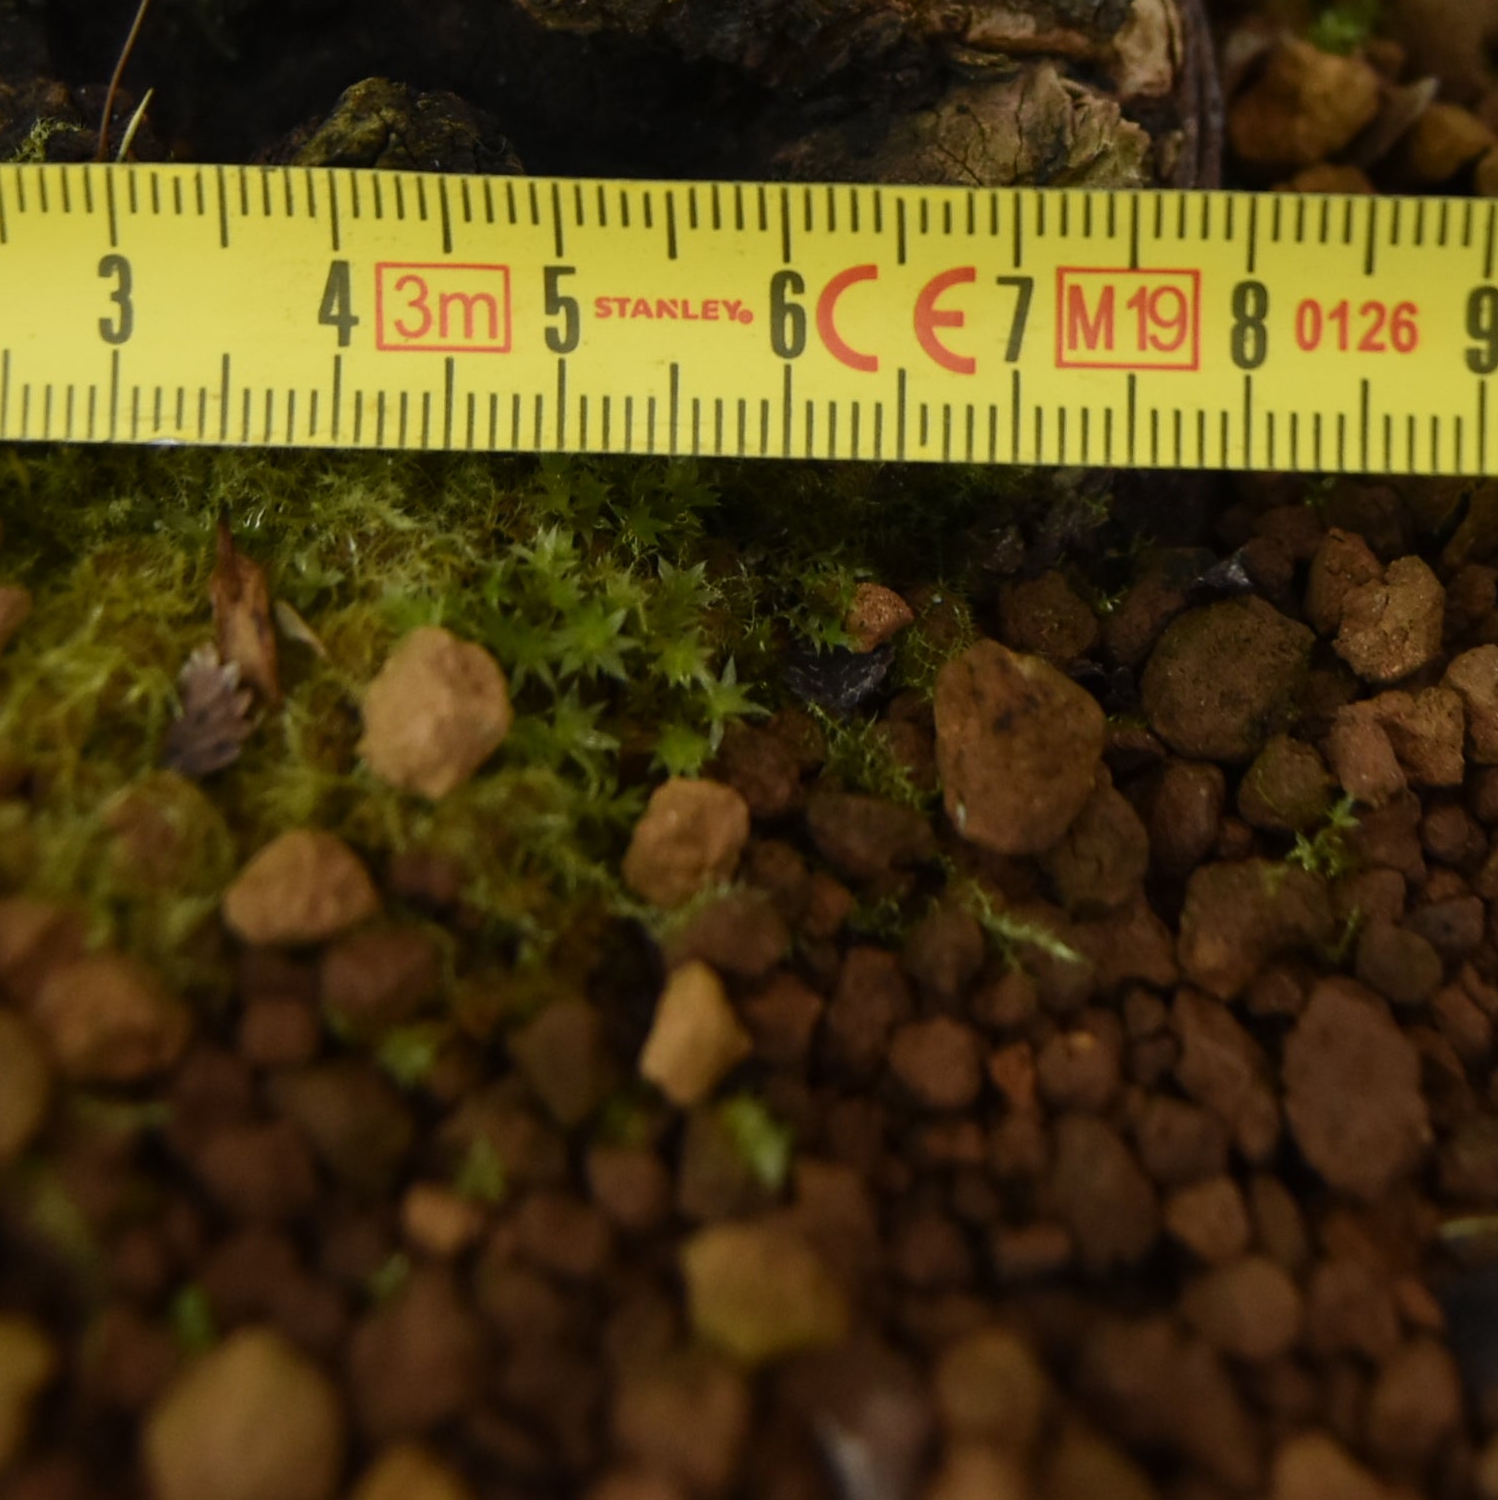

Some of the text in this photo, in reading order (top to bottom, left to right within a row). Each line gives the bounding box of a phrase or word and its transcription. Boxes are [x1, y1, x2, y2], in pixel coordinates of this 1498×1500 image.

[98, 253, 135, 345] 3
[317, 260, 359, 347] 4
[394, 274, 499, 340] 3m
[543, 266, 581, 353] 5
[593, 296, 743, 321] STANLEY
[769, 270, 807, 359] 6
[996, 276, 1035, 362] 7
[1230, 280, 1269, 369] 8
[1295, 299, 1419, 353] 0126
